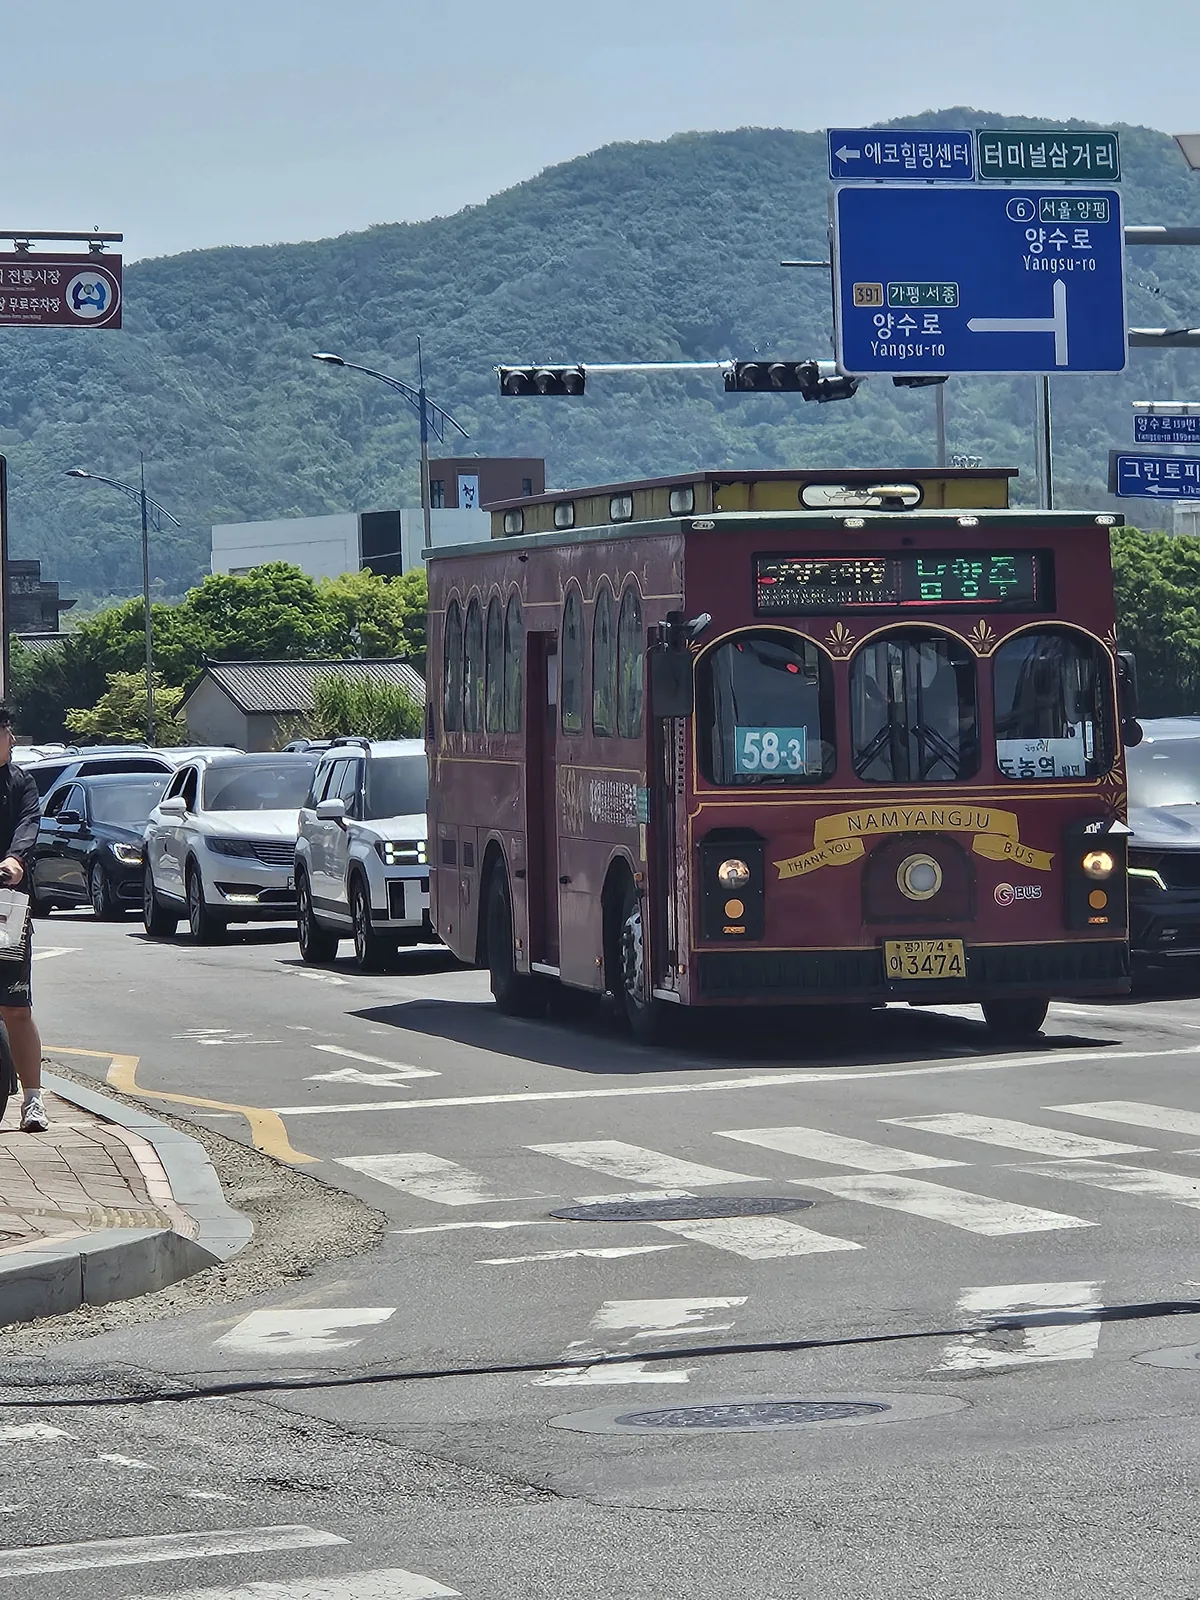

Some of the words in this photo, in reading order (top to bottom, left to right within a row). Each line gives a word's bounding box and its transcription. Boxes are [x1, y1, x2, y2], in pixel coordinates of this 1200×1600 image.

[864, 141, 969, 169] 에코힐링센터
[983, 141, 1114, 169] 터미널삼거리
[1016, 203, 1026, 216] 6
[1025, 228, 1092, 253] 양수로
[1023, 255, 1096, 273] Yangsu-ro
[8, 268, 61, 285] 전통시장
[9, 296, 61, 313] 무료주차장
[856, 286, 880, 303] 391
[873, 313, 942, 339] 양수로
[870, 341, 945, 359] Yangsu-ro
[1123, 462, 1200, 482] 그린토피
[847, 810, 990, 832] NAMYANGJU
[787, 851, 827, 872] THANK
[828, 842, 852, 855] YOU
[1003, 841, 1035, 864] BUS
